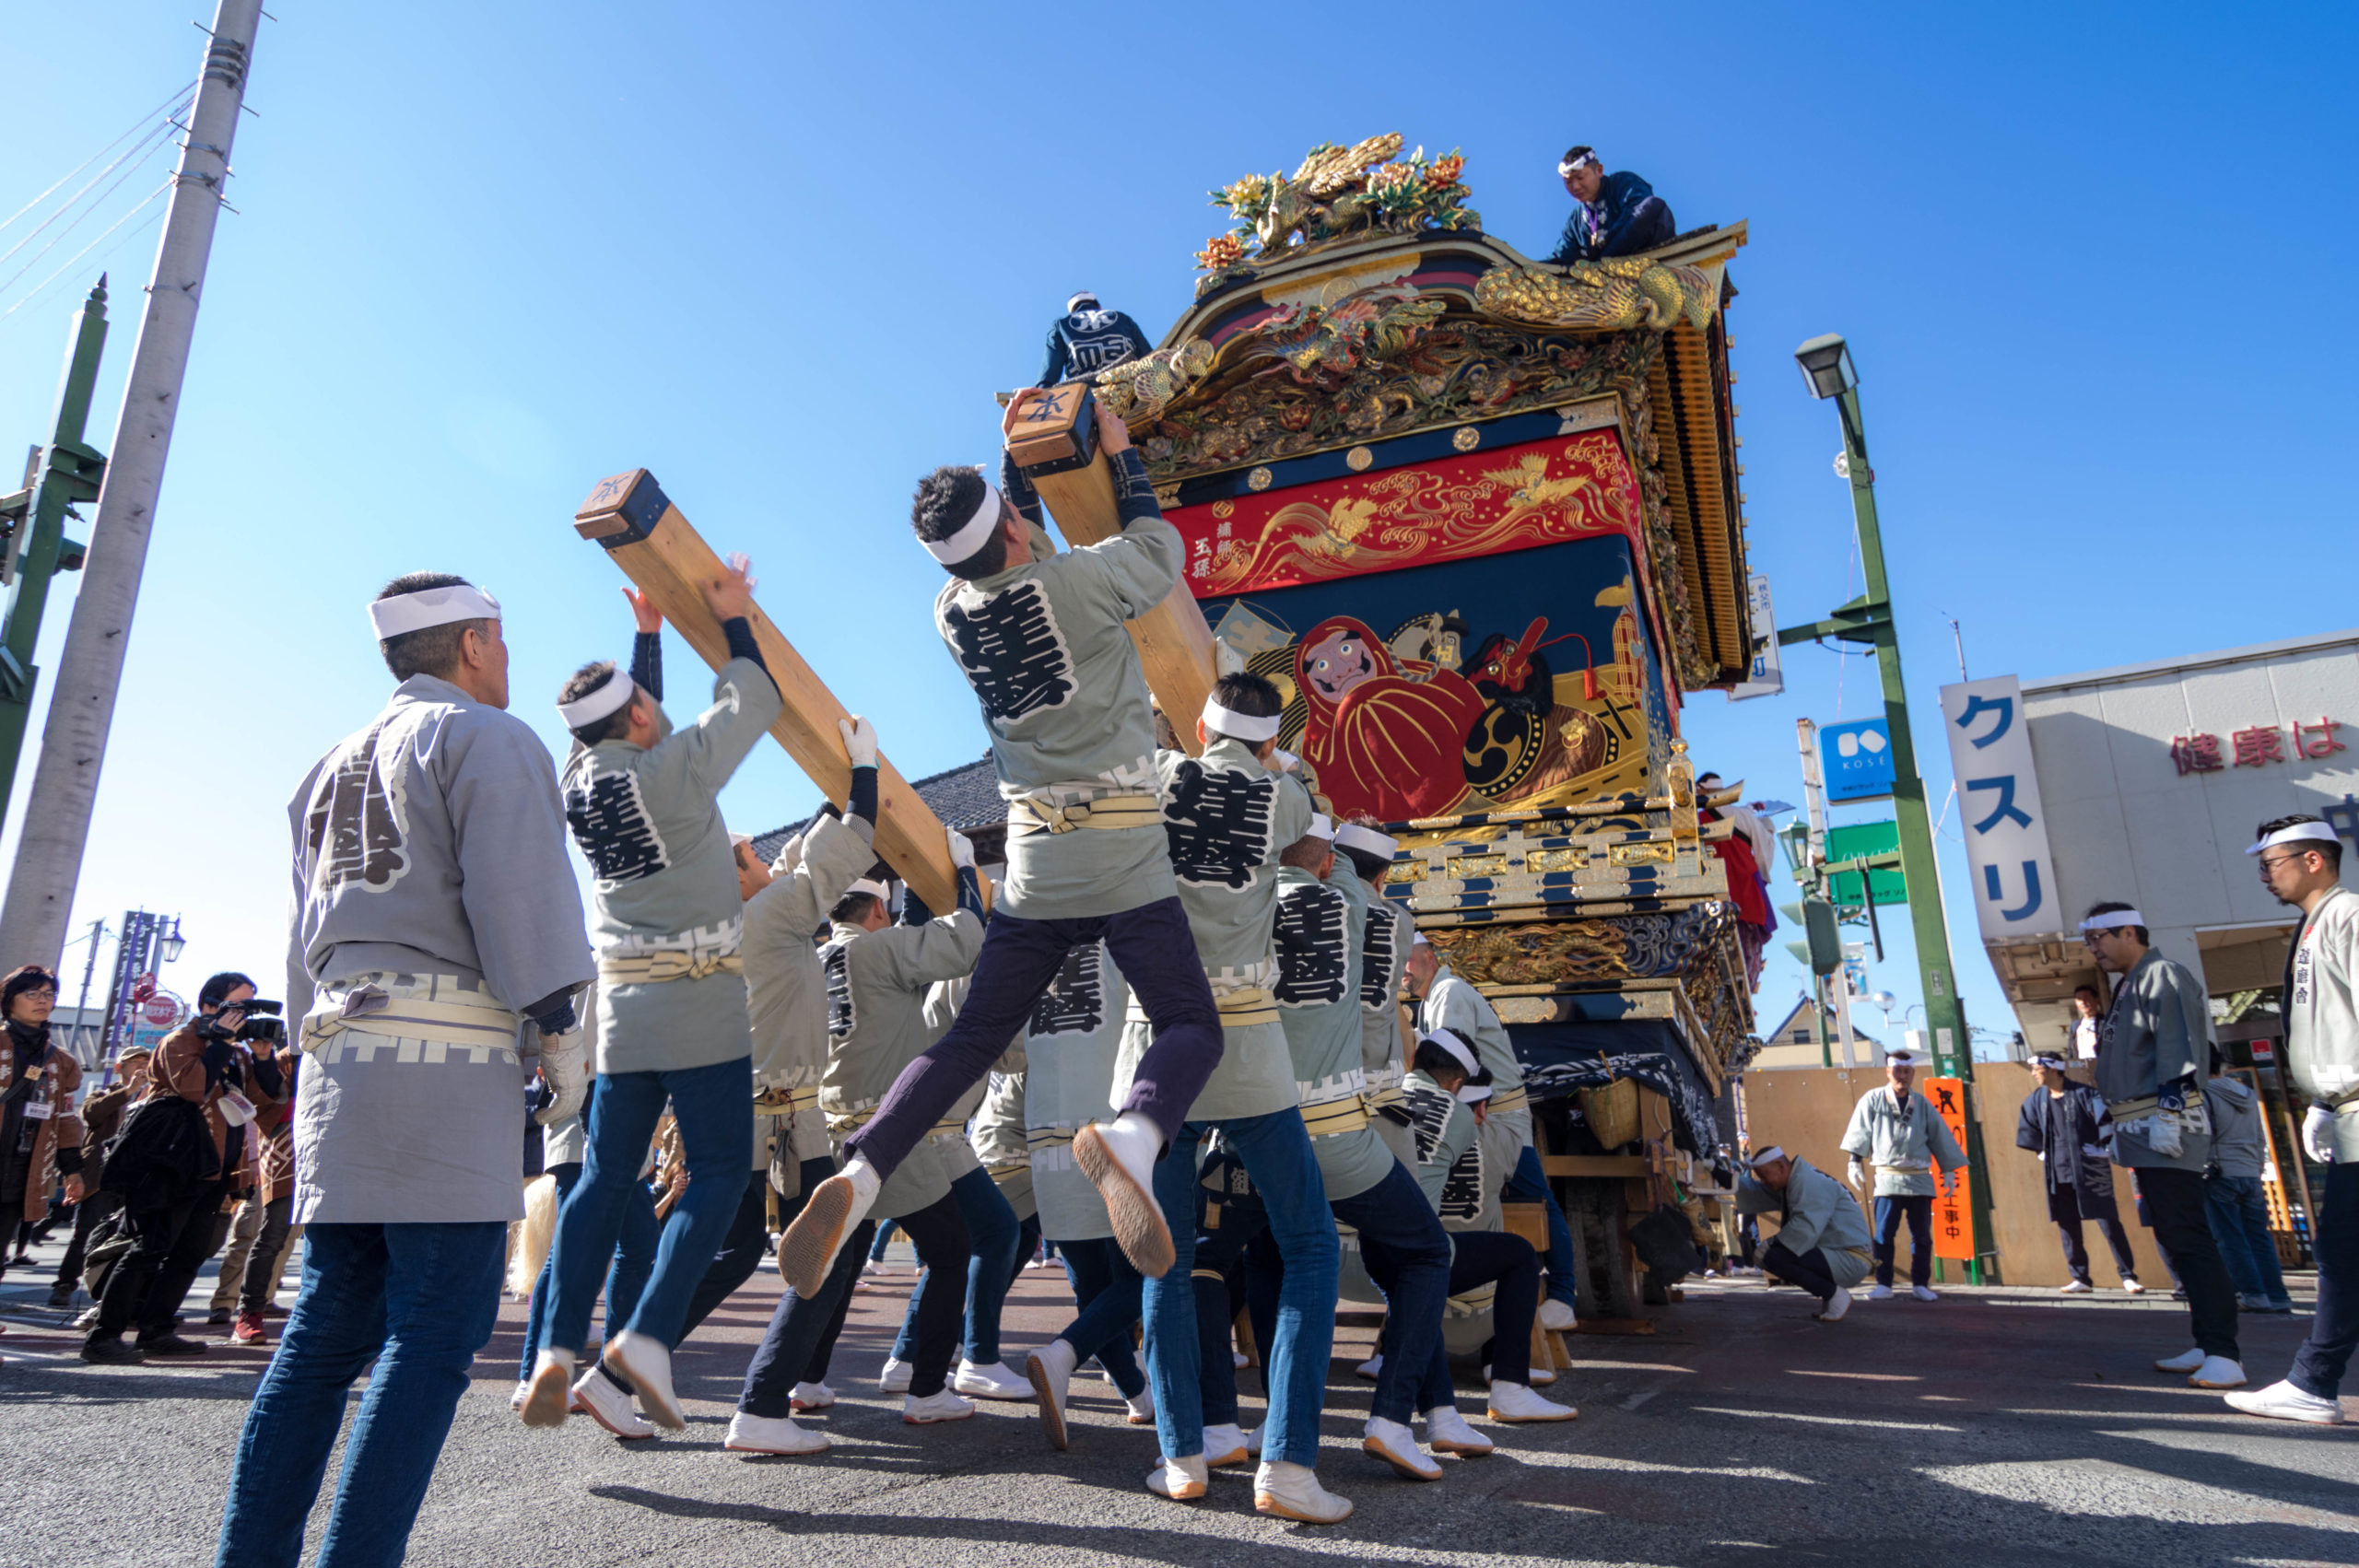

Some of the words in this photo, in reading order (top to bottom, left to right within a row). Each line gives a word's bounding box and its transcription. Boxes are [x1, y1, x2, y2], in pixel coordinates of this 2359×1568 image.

[1842, 755, 1885, 770] KOSÉ
[2170, 716, 2346, 777] 健康は
[1955, 695, 2043, 922] クスリ
